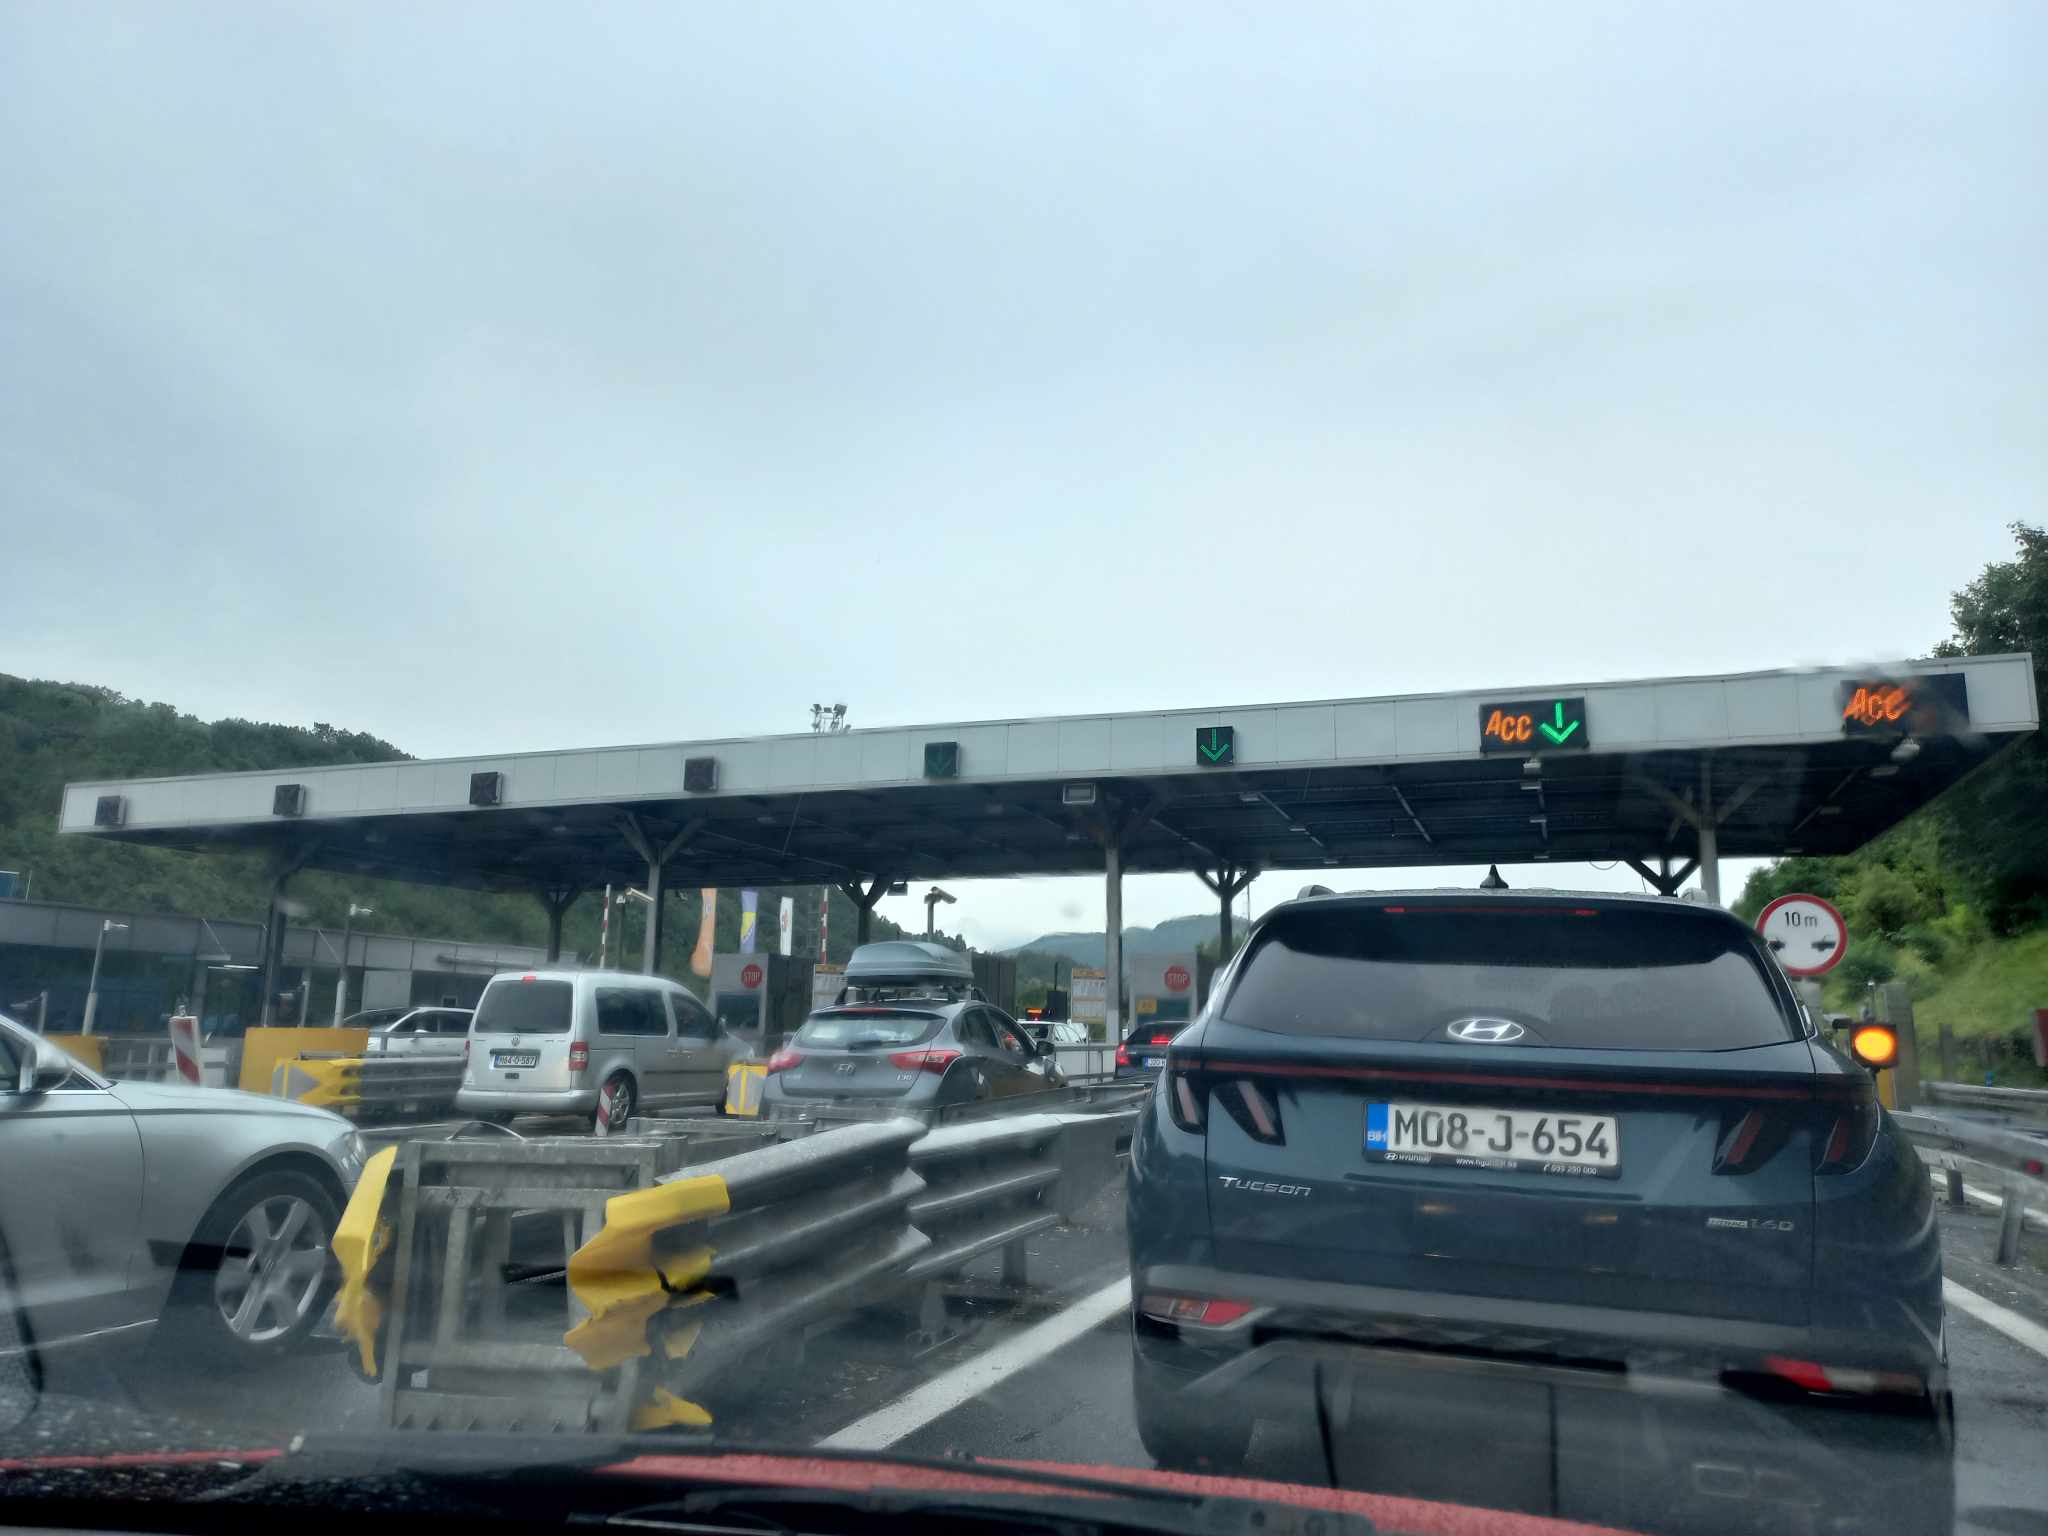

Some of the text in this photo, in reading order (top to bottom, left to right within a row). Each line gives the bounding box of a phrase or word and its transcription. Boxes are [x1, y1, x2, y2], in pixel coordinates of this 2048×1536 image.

[1485, 709, 1532, 741] ACC
[1785, 911, 1818, 928] 10 m
[743, 971, 761, 981] STOP
[1167, 972, 1188, 985] STOP
